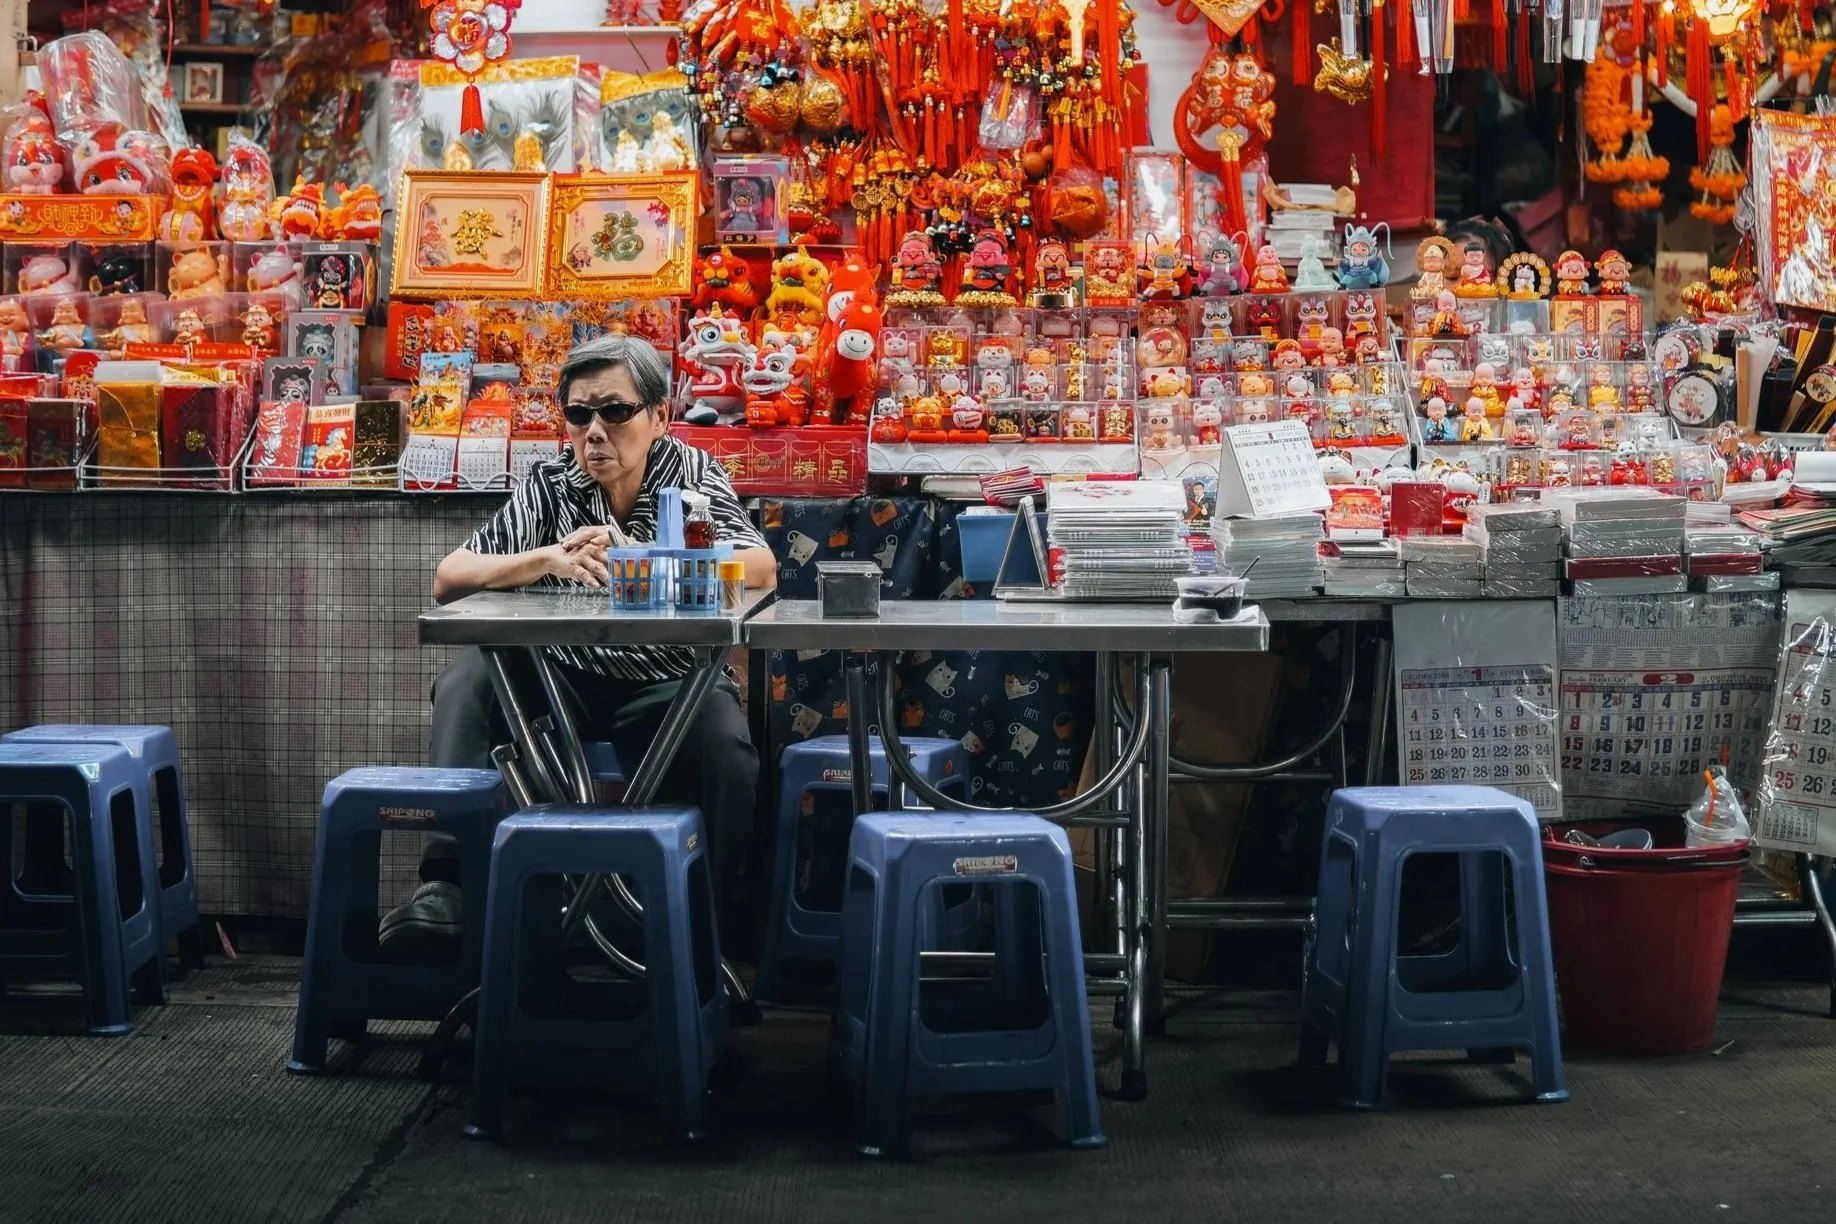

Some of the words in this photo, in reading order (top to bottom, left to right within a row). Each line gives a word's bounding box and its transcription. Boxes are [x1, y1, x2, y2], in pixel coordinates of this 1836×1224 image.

[793, 458, 818, 480] 精
[827, 459, 849, 484] 品
[793, 500, 806, 519] CATS
[893, 514, 911, 530] CATS
[781, 568, 799, 580] CATS
[1471, 667, 1483, 681] 1
[1660, 674, 1677, 684] 2
[1493, 687, 1501, 698] 1
[1515, 685, 1524, 697] 2
[1537, 685, 1545, 697] 3
[1574, 692, 1581, 708] 1
[1602, 692, 1612, 708] 2
[1632, 692, 1642, 709] 3
[1661, 692, 1672, 708] 4
[1690, 691, 1701, 707] 5
[1720, 690, 1731, 706] 6
[1821, 689, 1831, 706] 5
[938, 707, 957, 723] CATS
[1023, 706, 1040, 722] CATS
[1411, 709, 1419, 721] 4
[1432, 708, 1440, 720] 5
[1452, 707, 1461, 720] 6
[1474, 707, 1482, 719] 7
[1495, 706, 1503, 718] 8
[1516, 705, 1524, 717] 9
[1569, 715, 1580, 731] 8
[1600, 716, 1610, 731] 9
[1625, 716, 1645, 732] 10
[1657, 715, 1675, 731] 11
[1685, 714, 1704, 730] 12
[1713, 713, 1733, 729] 13
[1812, 717, 1831, 736] 12
[1408, 729, 1421, 741] 11
[1430, 728, 1444, 739] 12
[1471, 726, 1486, 738] 14
[1493, 725, 1507, 737] 15
[1514, 725, 1528, 736] 16
[1535, 724, 1548, 736] 17
[1409, 749, 1423, 761] 18
[1430, 748, 1445, 760] 19
[1451, 747, 1466, 759] 20
[1472, 747, 1487, 758] 21
[1493, 745, 1508, 757] 22
[1514, 744, 1529, 757] 23
[1535, 743, 1550, 755] 24
[1563, 736, 1583, 751] 15
[1593, 737, 1613, 753] 16
[1624, 739, 1643, 754] 17
[1653, 738, 1673, 754] 18
[1683, 737, 1701, 753] 19
[1808, 746, 1827, 765] 19
[998, 760, 1015, 771] CATS
[1053, 760, 1070, 771] CATS
[1409, 769, 1425, 781] 25
[1430, 768, 1446, 779] 26
[1451, 767, 1467, 779] 27
[1473, 766, 1488, 778] 28
[1494, 765, 1509, 777] 29
[1515, 764, 1530, 776] 30
[1561, 755, 1582, 770] 22
[1590, 758, 1612, 773] 23
[1619, 760, 1642, 775] 24
[1650, 760, 1671, 777] 25
[1679, 759, 1700, 775] 26
[1775, 771, 1795, 790] 25
[1802, 774, 1823, 793] 26
